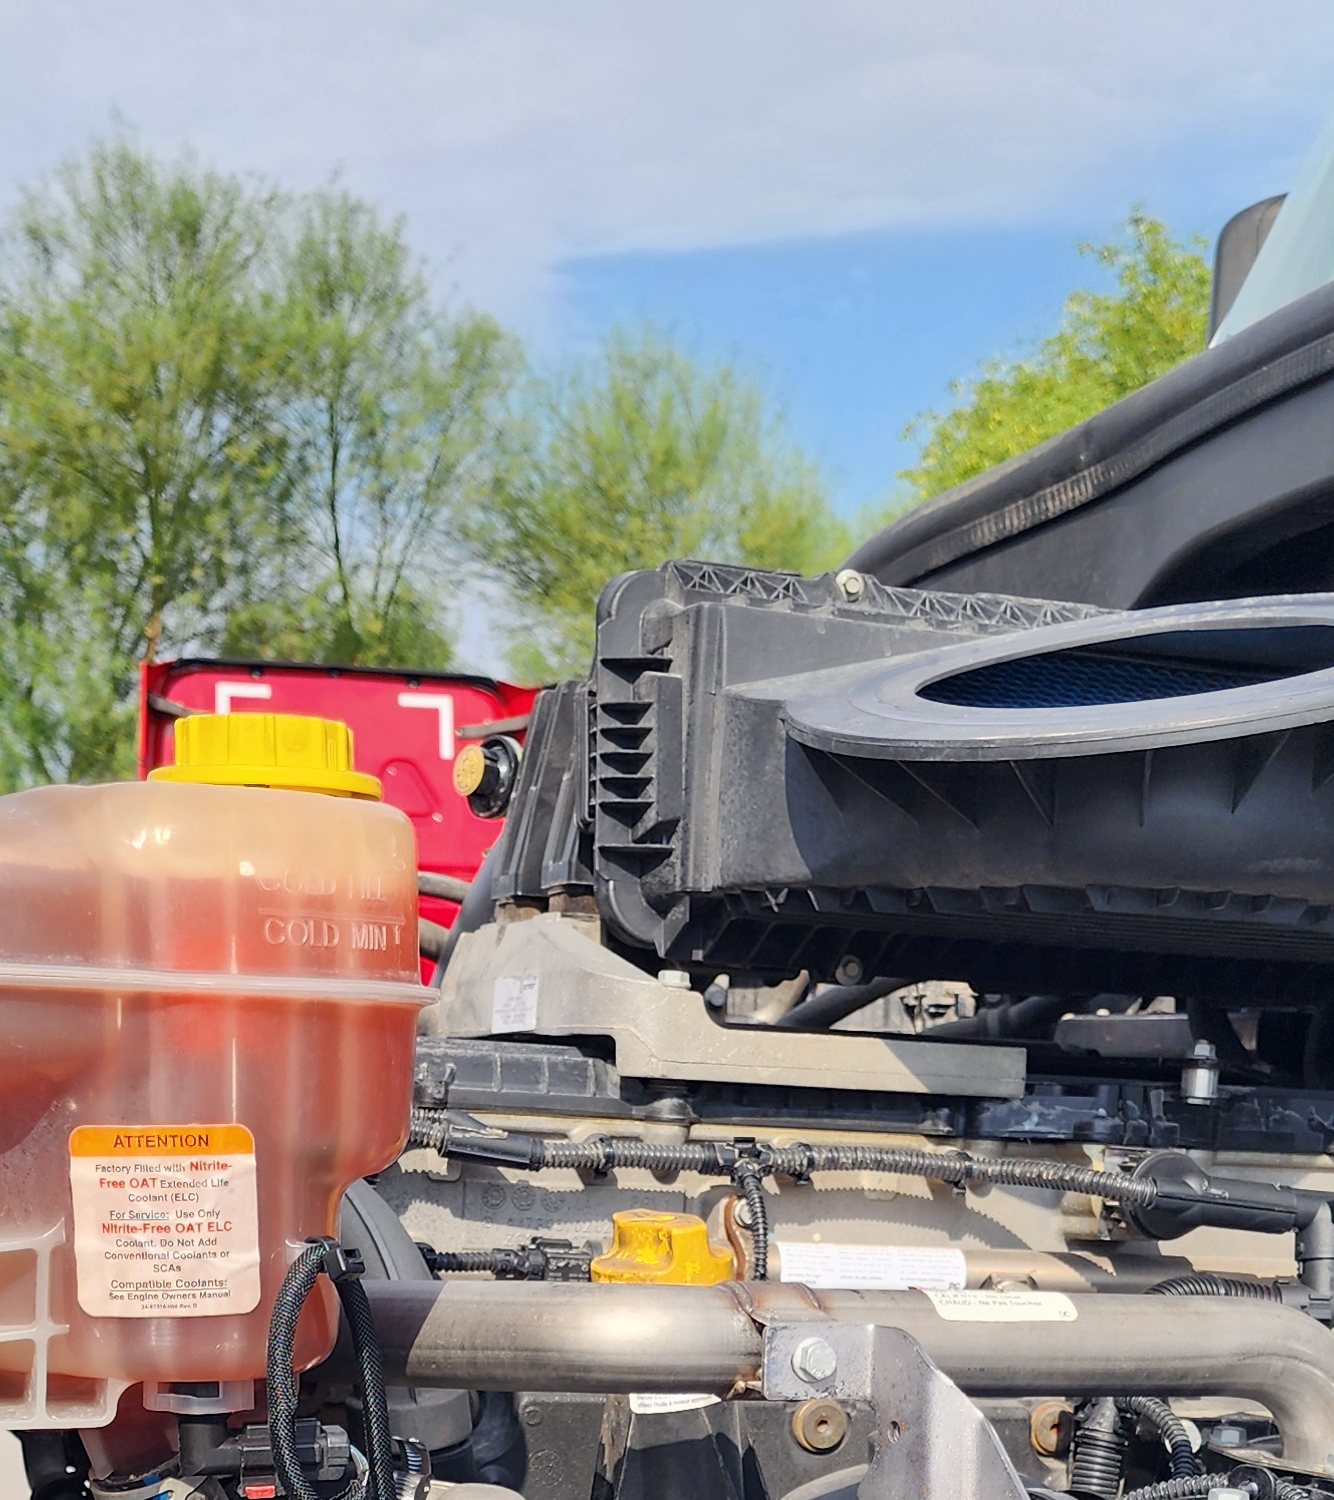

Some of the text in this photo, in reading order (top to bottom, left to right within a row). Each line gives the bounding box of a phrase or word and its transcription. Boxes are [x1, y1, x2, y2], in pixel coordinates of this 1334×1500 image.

[264, 917, 387, 951] COLD MIN
[113, 1134, 210, 1148] ATTENTION
[95, 1161, 233, 1174] Factory Filled with Nitrite-
[99, 1178, 229, 1189] Free OAT Extended Life
[128, 1193, 199, 1204] Coolant (ELC)
[109, 1209, 220, 1220] For Service: Use Only
[102, 1222, 233, 1234] Nitrite-Free OAT ELC
[115, 1238, 217, 1248] Coolant. Do Not Add
[104, 1252, 169, 1260] Conventional
[172, 1251, 216, 1260] Coolants
[153, 1264, 182, 1273] SCAs
[110, 1278, 228, 1290] Compatible Coolants:
[109, 1290, 231, 1302] See Engine Owners Manual
